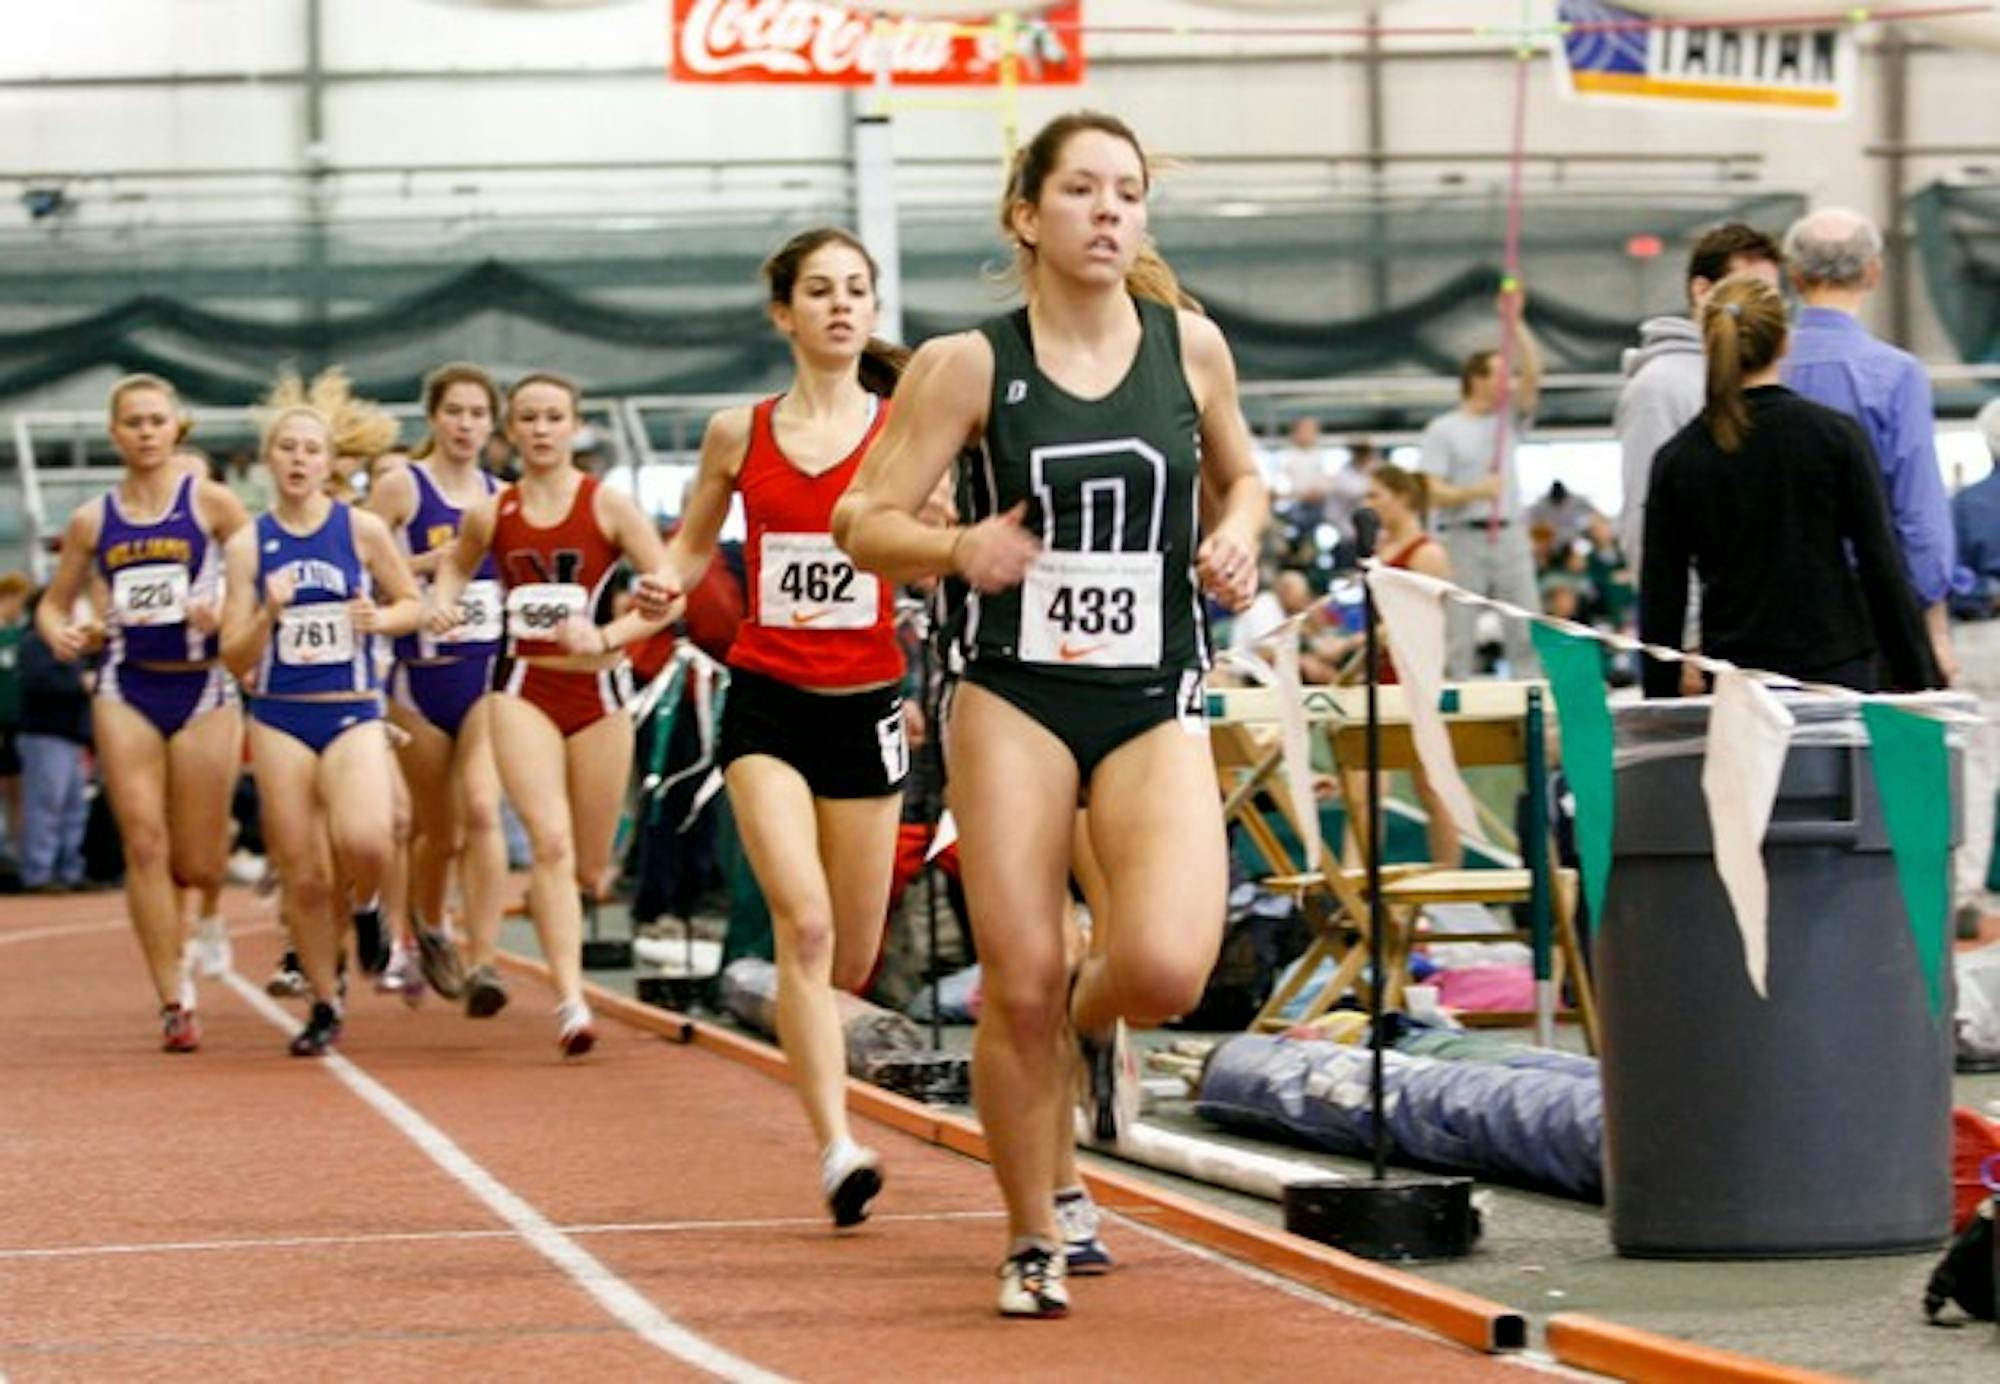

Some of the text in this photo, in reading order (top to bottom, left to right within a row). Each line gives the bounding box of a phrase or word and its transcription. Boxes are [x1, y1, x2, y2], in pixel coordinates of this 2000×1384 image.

[780, 562, 856, 603] 462
[1047, 586, 1136, 635] 433
[293, 620, 337, 648] 761
